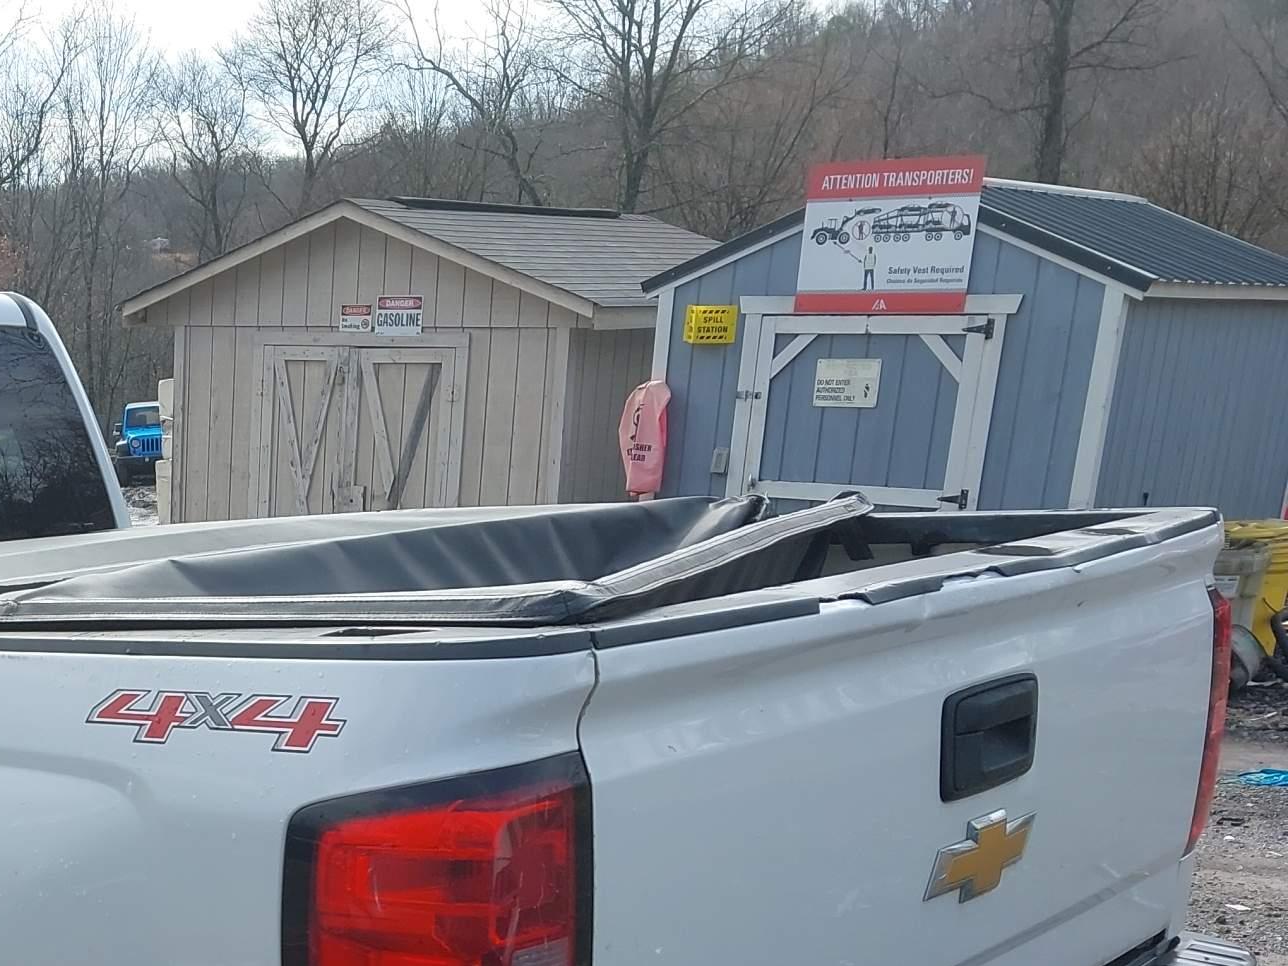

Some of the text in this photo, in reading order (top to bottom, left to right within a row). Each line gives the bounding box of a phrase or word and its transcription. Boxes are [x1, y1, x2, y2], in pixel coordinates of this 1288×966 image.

[821, 168, 974, 190] ATTENTION TRANSPORTERS!
[887, 264, 965, 275] Safety Vest Required
[385, 299, 414, 308] DANGER
[376, 312, 421, 328] GASOLINE
[703, 316, 723, 324] SPILL
[697, 325, 728, 334] STATION
